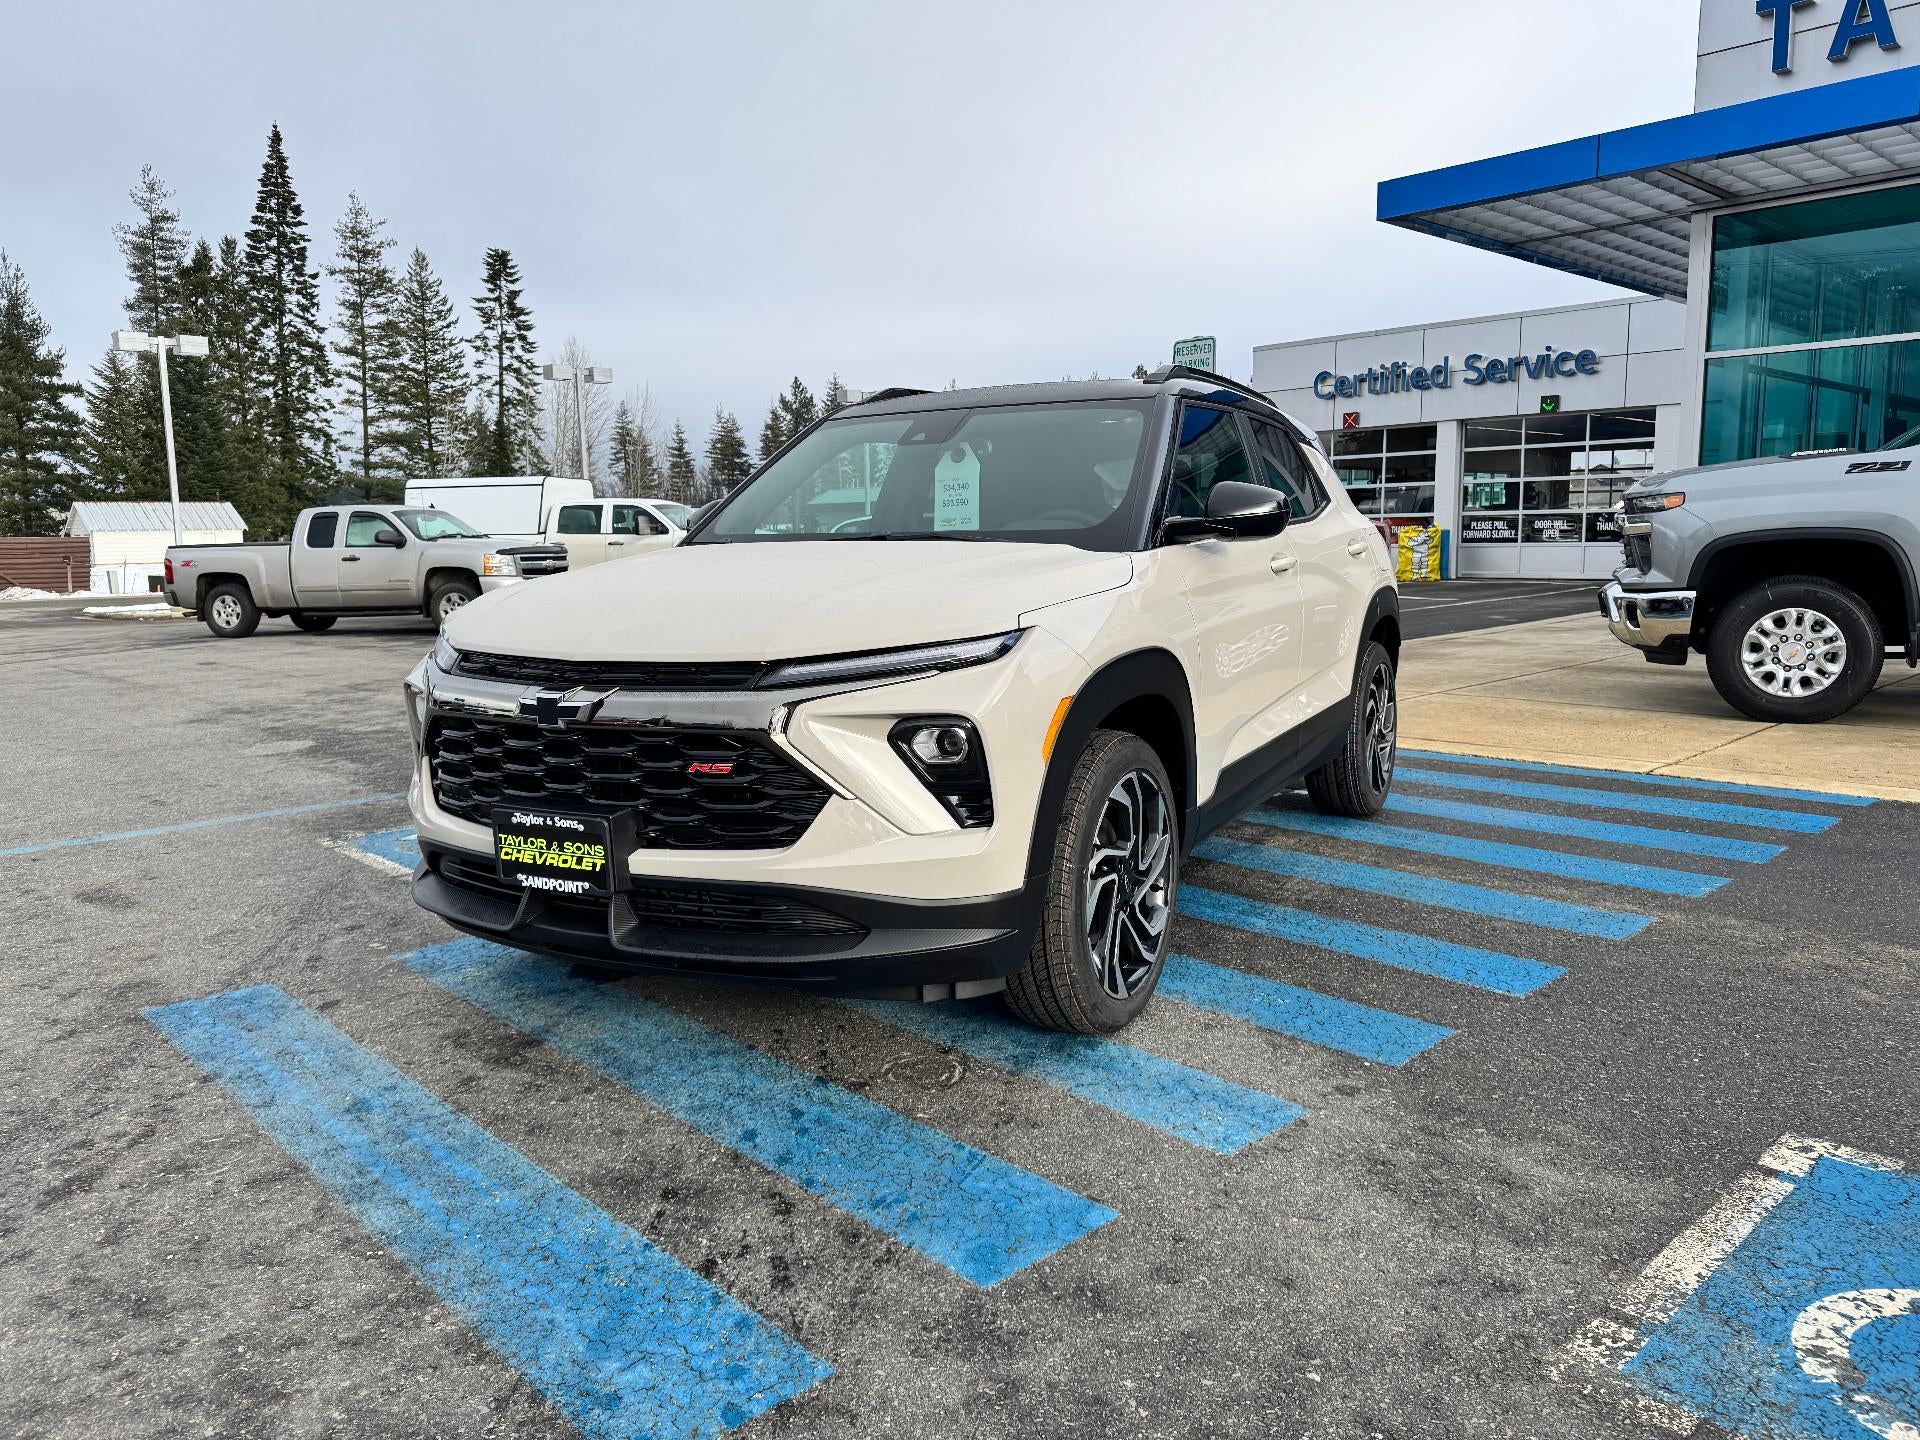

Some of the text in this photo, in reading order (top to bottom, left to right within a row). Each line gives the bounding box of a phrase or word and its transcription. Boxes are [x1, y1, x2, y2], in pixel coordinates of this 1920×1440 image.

[1177, 344, 1212, 357] RESERVED
[1313, 345, 1599, 401] Certified Service
[1471, 521, 1509, 530] PLEASE PULL
[1534, 520, 1568, 529] DOOR WILL
[1596, 521, 1615, 531] THAN
[1463, 530, 1516, 539] FORWARD SLOWLY
[1543, 529, 1560, 538] OPEN
[688, 762, 734, 774] RS
[514, 812, 579, 829] Taylor & Sons
[499, 833, 605, 857] TAYLOR & SONS
[500, 847, 606, 872] CHEVROLET
[521, 874, 584, 894] SANDPOINT
